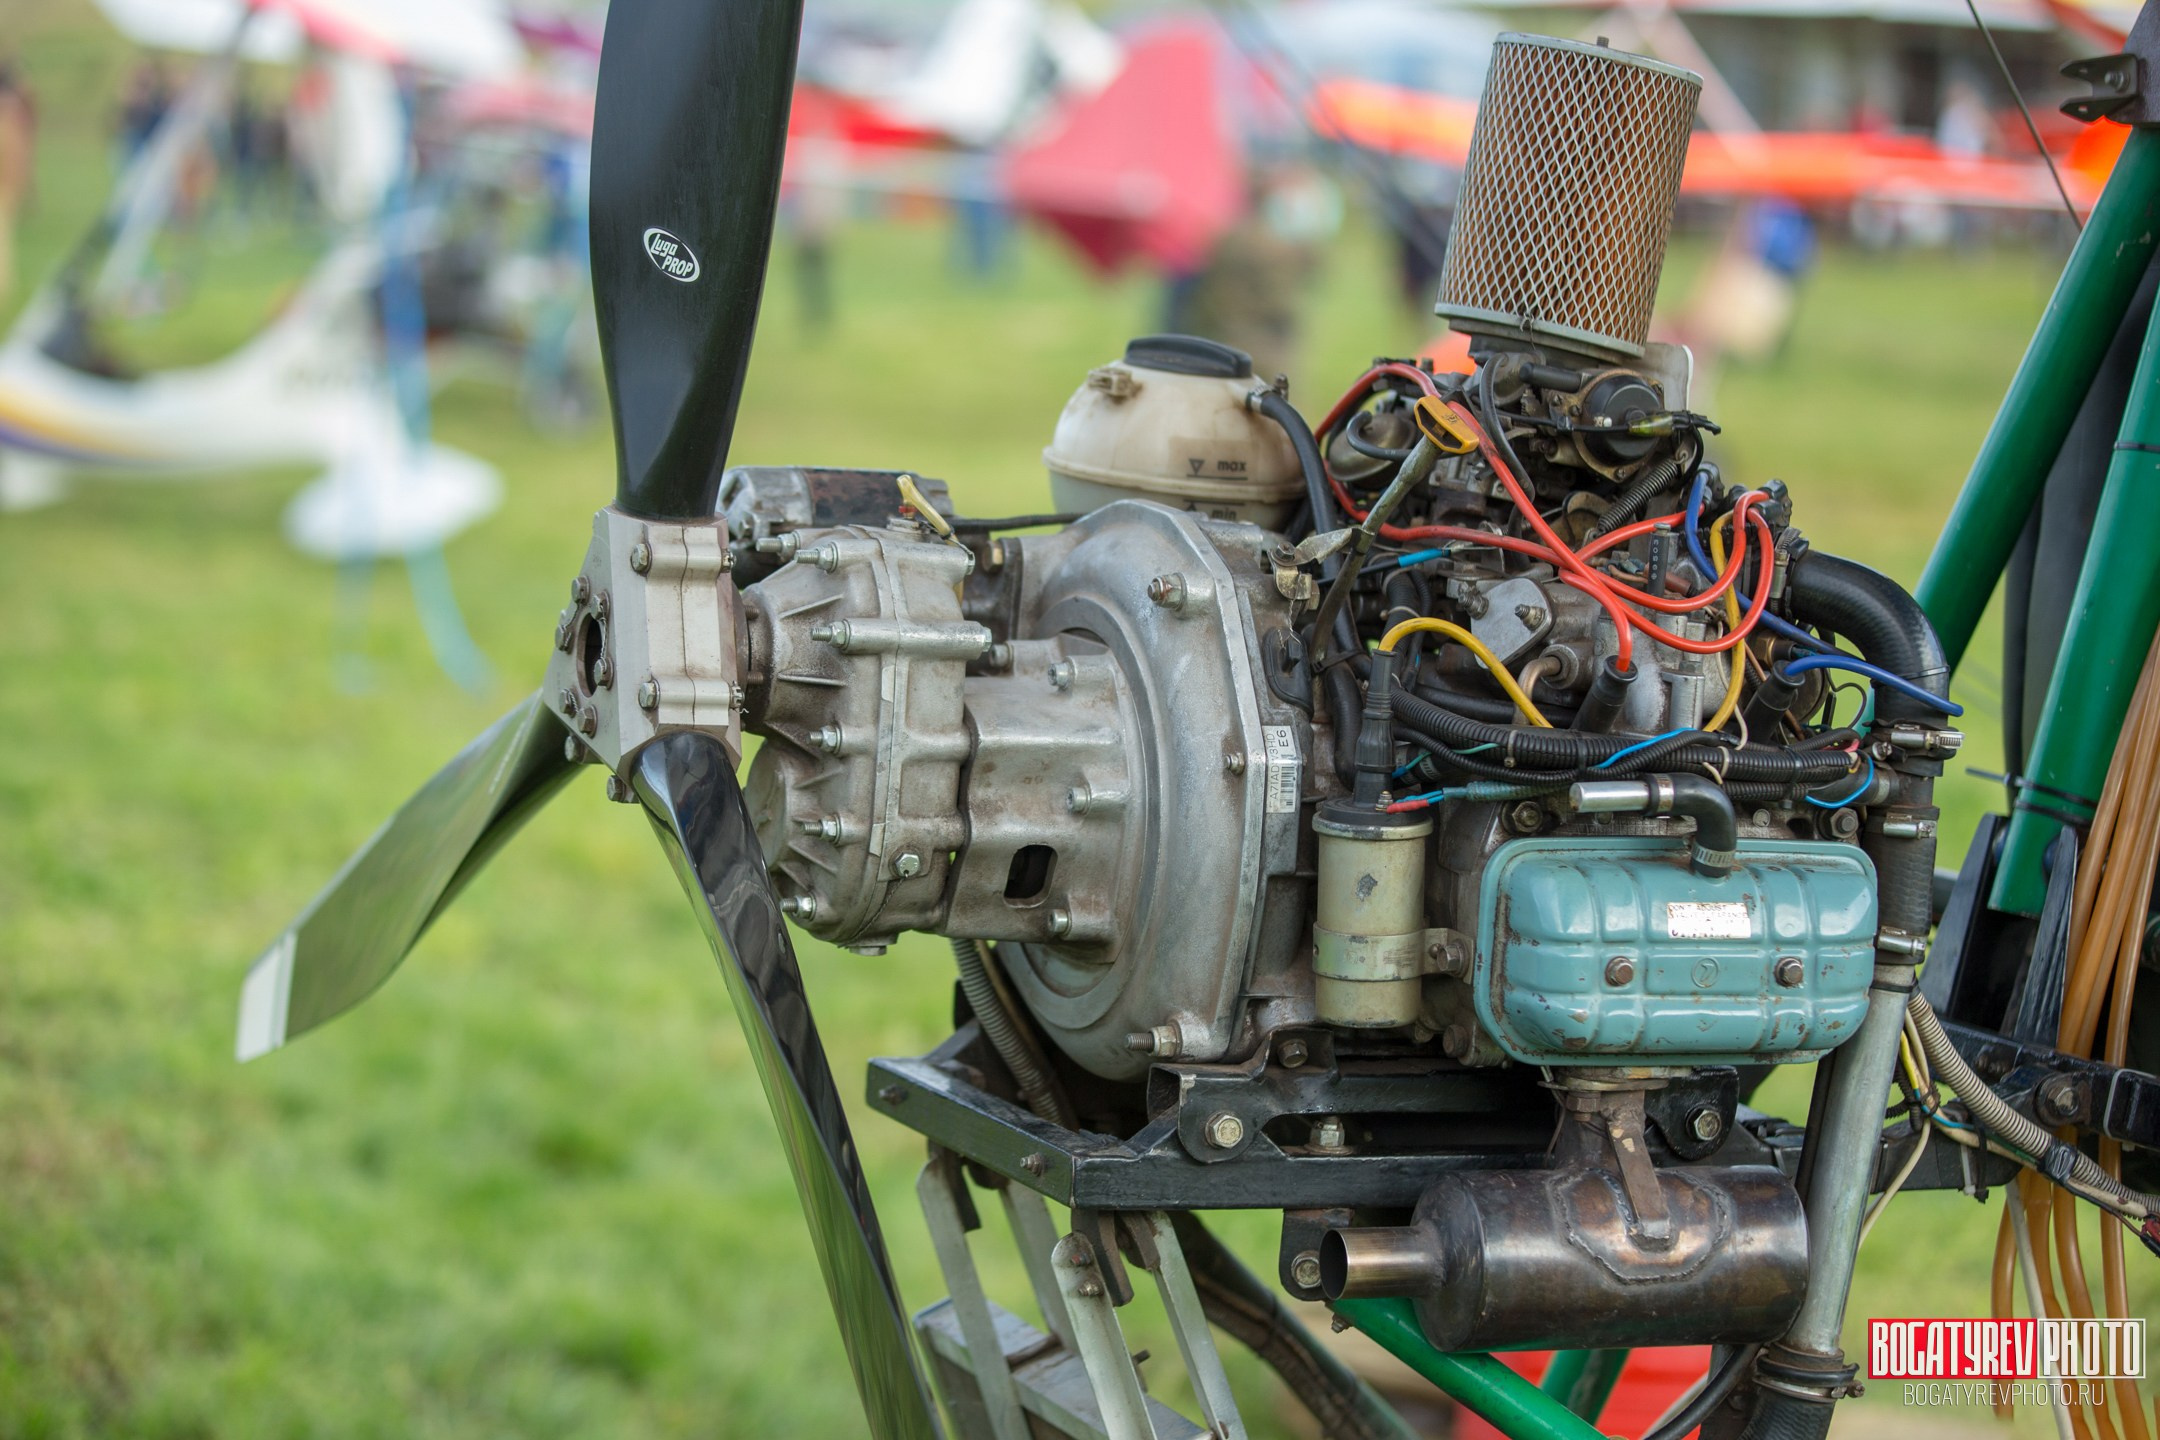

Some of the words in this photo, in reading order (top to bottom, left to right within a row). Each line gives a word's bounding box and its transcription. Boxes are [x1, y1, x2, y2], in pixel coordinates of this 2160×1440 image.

[650, 233, 679, 258] Luga
[661, 255, 694, 277] PROP
[1217, 460, 1247, 472] max
[1211, 507, 1237, 521] min
[1276, 729, 1289, 747] E6
